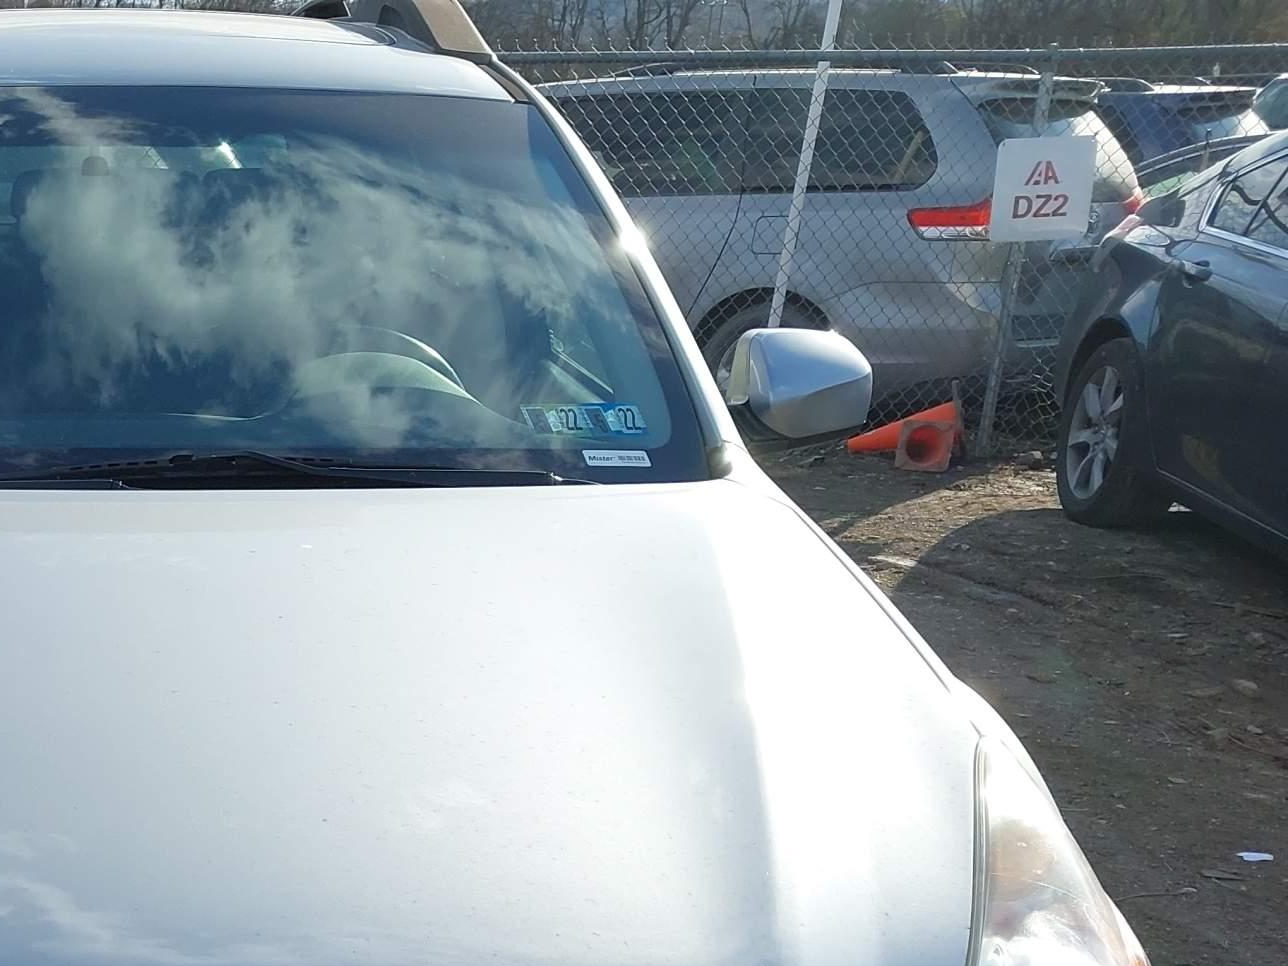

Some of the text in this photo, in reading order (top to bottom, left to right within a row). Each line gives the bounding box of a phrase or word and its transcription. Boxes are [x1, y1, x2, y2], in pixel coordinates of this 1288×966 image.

[1012, 194, 1069, 219] DZ2
[559, 408, 583, 430] 22
[617, 407, 642, 430] 22
